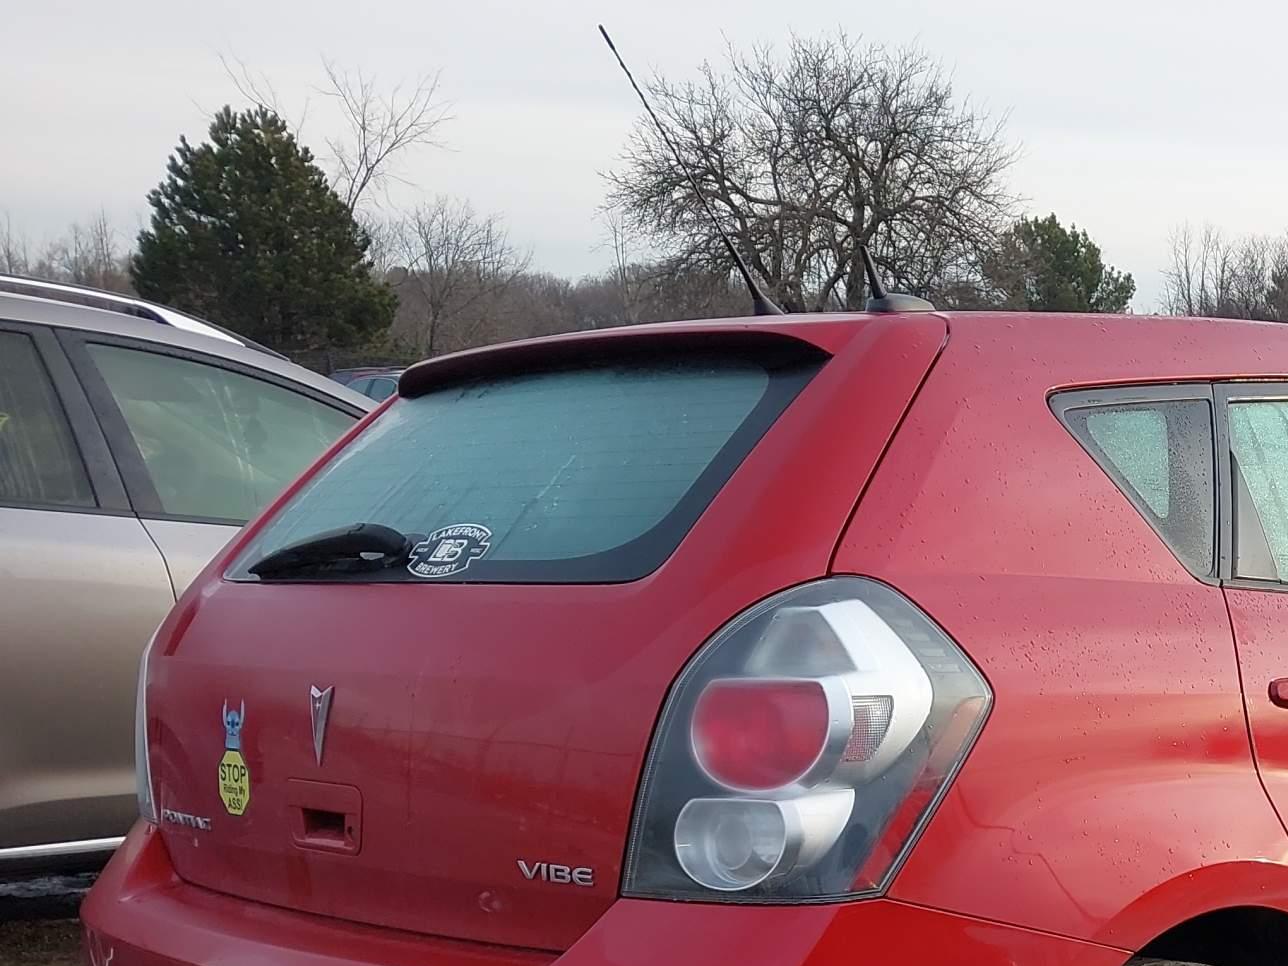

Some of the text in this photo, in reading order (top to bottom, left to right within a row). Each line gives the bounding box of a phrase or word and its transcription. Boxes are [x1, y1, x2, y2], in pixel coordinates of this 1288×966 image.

[432, 526, 487, 541] LAKEFRONT
[415, 562, 459, 574] BREWERY
[220, 763, 246, 784] STOP
[162, 809, 212, 830] PONTIAC
[517, 860, 594, 887] VIBE
